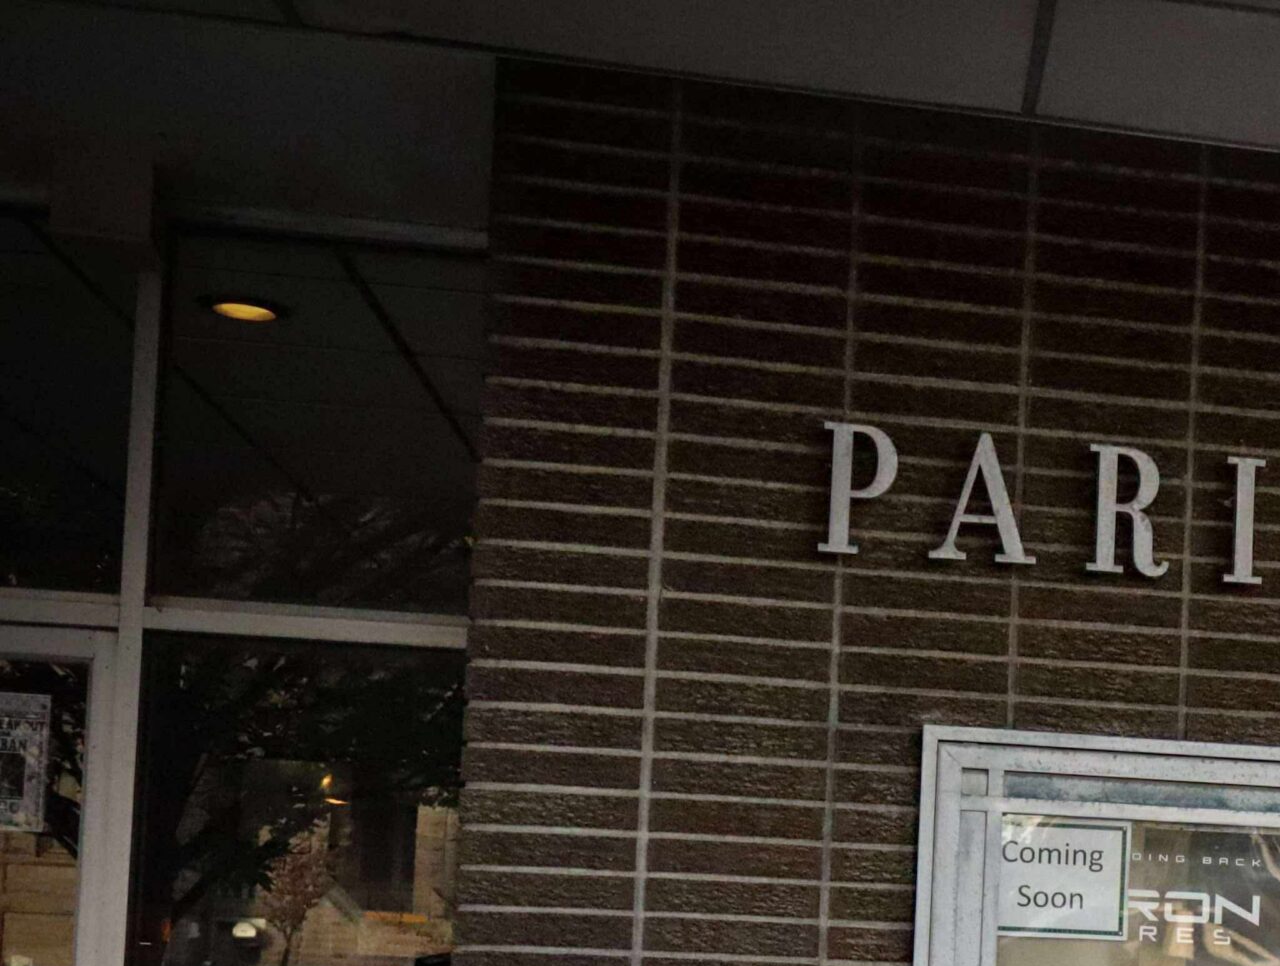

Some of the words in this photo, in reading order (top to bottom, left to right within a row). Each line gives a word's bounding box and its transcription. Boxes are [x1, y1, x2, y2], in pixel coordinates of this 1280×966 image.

[1002, 840, 1103, 872] Coming
[1202, 856, 1262, 867] BACK
[1017, 885, 1083, 910] Soon
[1128, 888, 1260, 927] RON
[1139, 925, 1231, 945] RES
